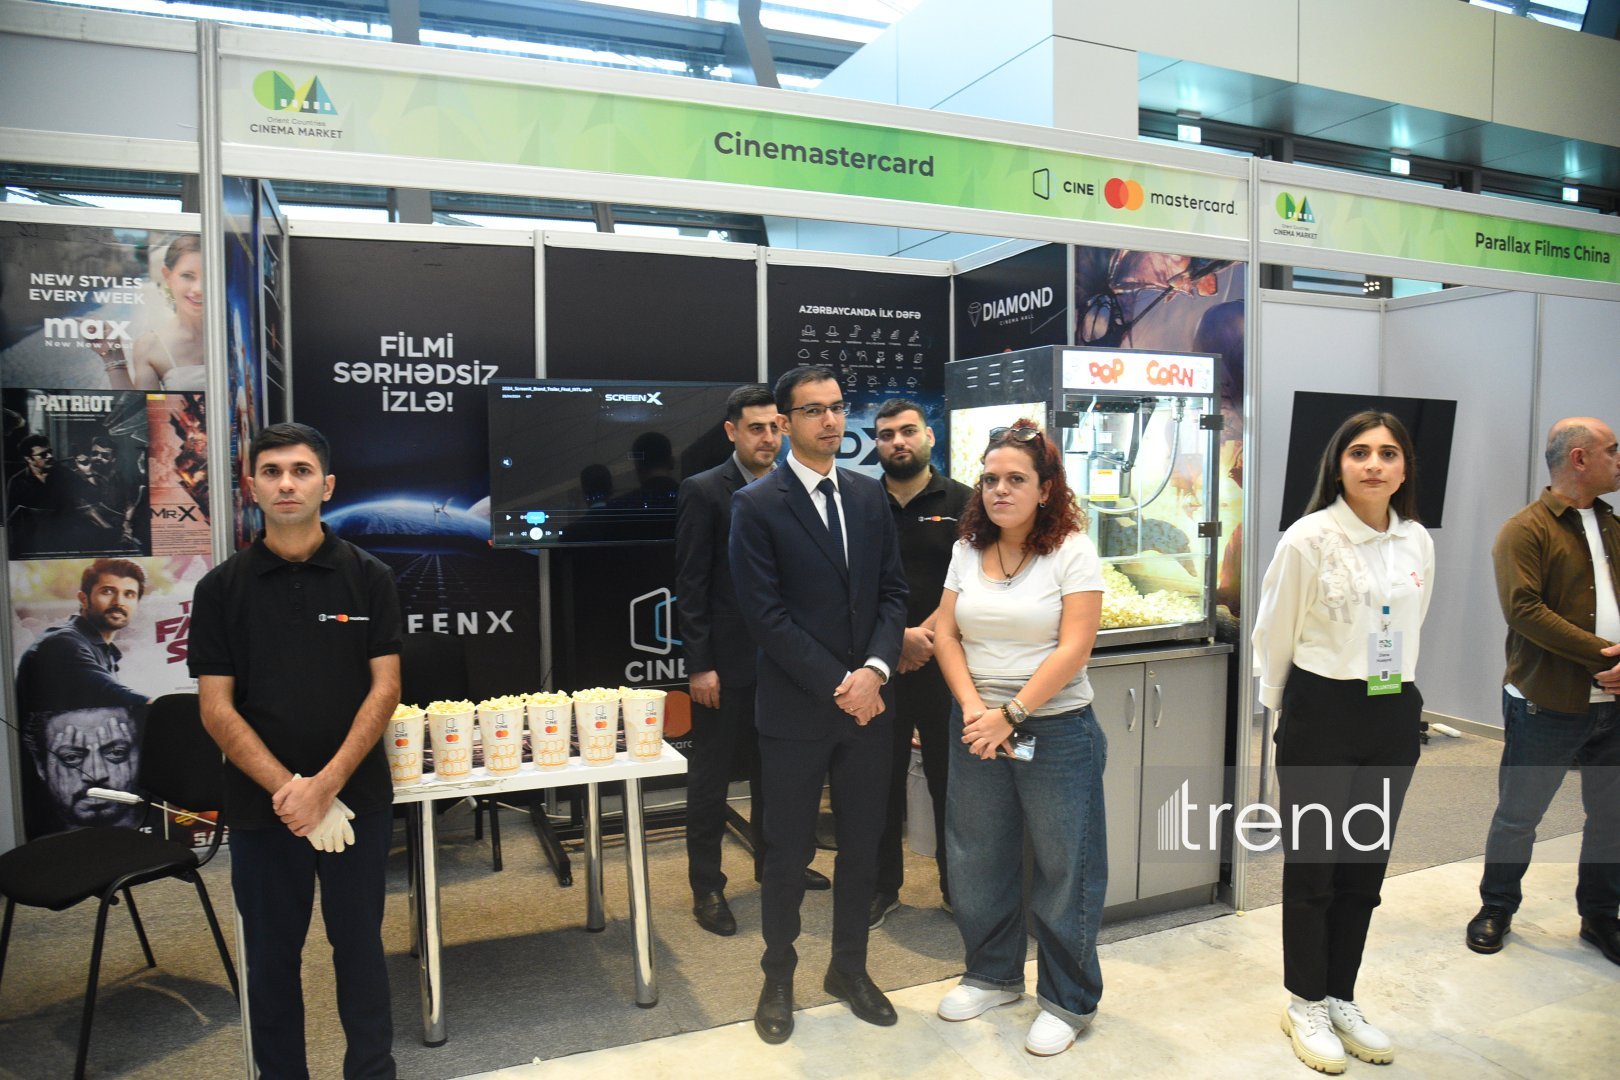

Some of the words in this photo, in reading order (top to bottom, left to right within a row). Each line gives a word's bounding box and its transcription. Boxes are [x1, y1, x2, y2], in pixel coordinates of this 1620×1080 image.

[249, 123, 295, 136] CINEMA
[298, 126, 343, 139] MARKET
[713, 131, 935, 178] Cinemastercard
[1063, 180, 1095, 196] CINE
[1273, 228, 1295, 237] CINEMA
[1295, 231, 1319, 240] MARKET
[1475, 232, 1531, 255] Parallax
[1534, 239, 1571, 259] Films
[1573, 245, 1611, 264] China
[30, 272, 75, 287] NEW
[79, 275, 144, 289] STYLES
[28, 288, 88, 303] EVERY
[92, 291, 145, 305] WEEK
[983, 286, 1054, 321] DIAMOND
[44, 317, 133, 340] max
[999, 317, 1019, 326] CINEMA
[380, 331, 454, 359] FİLMİ
[1088, 358, 1125, 385] POP
[1146, 359, 1194, 388] CORN
[34, 394, 115, 413] PATRIOT
[382, 386, 454, 412] İZLƏ!
[604, 391, 664, 406] SCREENX
[624, 658, 689, 683] CINE
